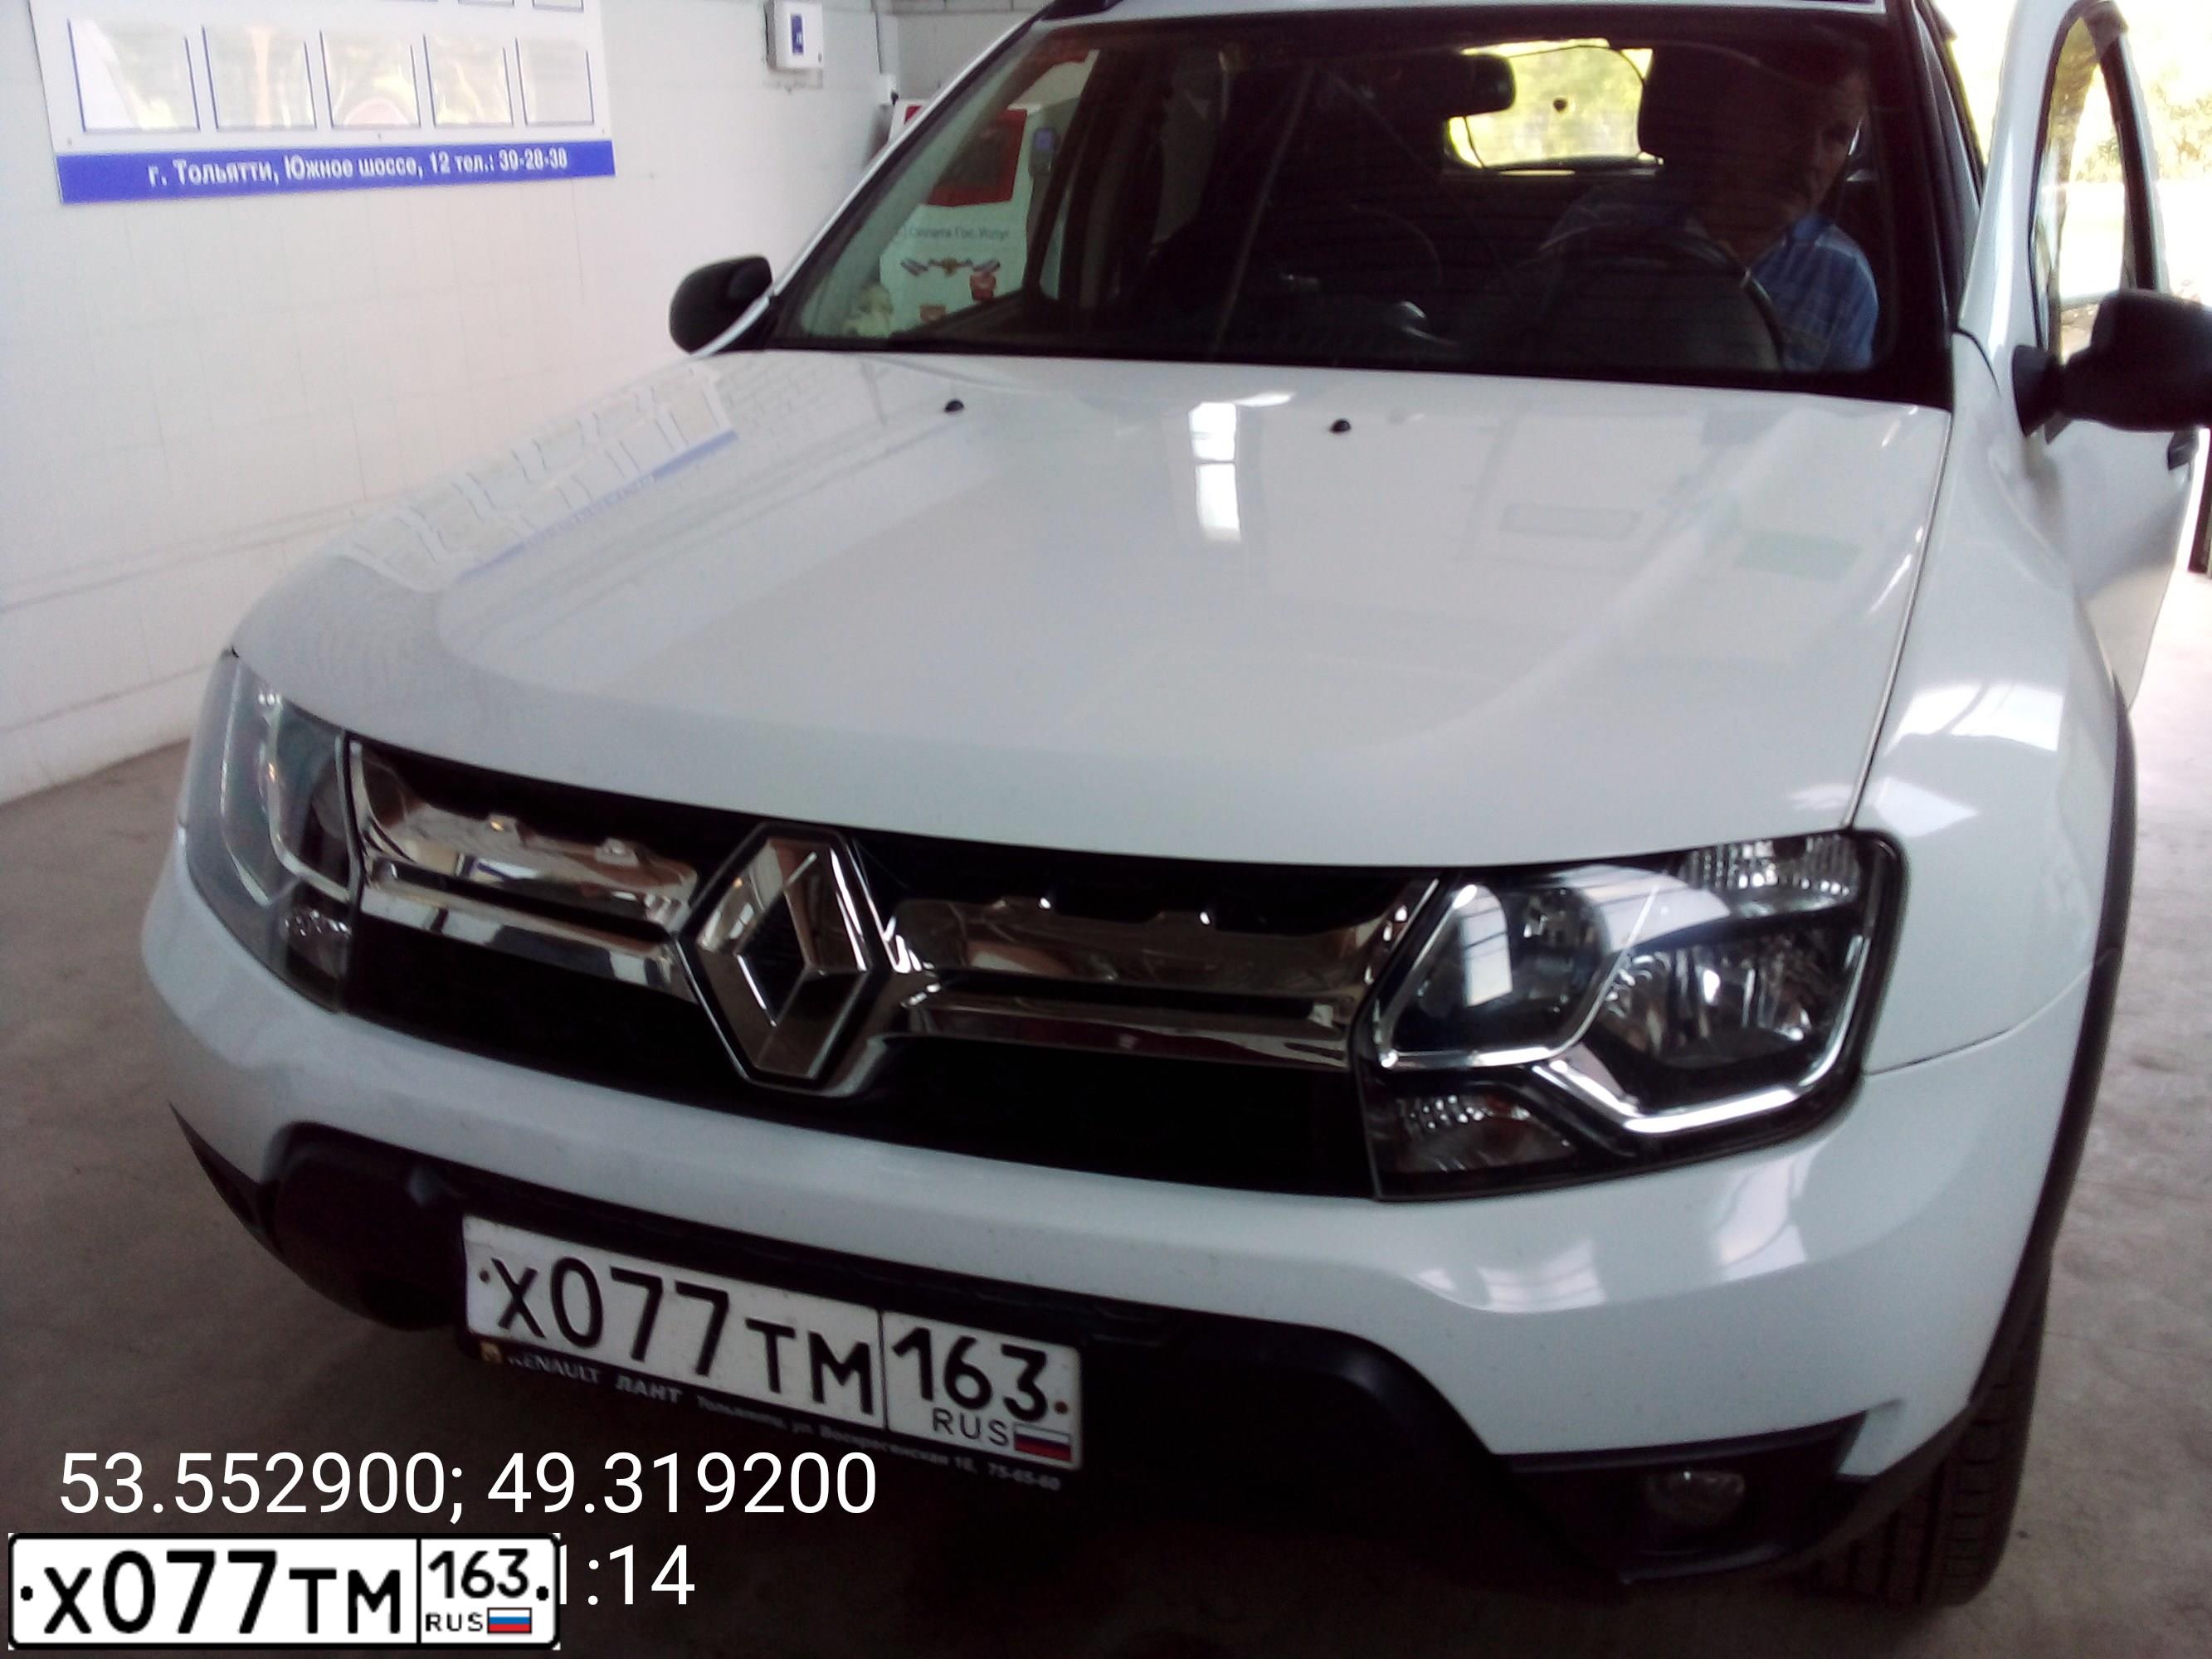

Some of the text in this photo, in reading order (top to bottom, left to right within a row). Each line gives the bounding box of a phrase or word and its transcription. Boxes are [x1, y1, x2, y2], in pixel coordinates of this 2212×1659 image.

[172, 158, 280, 185] Тольятти,
[283, 154, 353, 180] Южное
[358, 157, 423, 179] шоссе,
[429, 151, 451, 174] 12
[892, 1326, 1047, 1422] 163
[933, 1407, 1009, 1447] RUS
